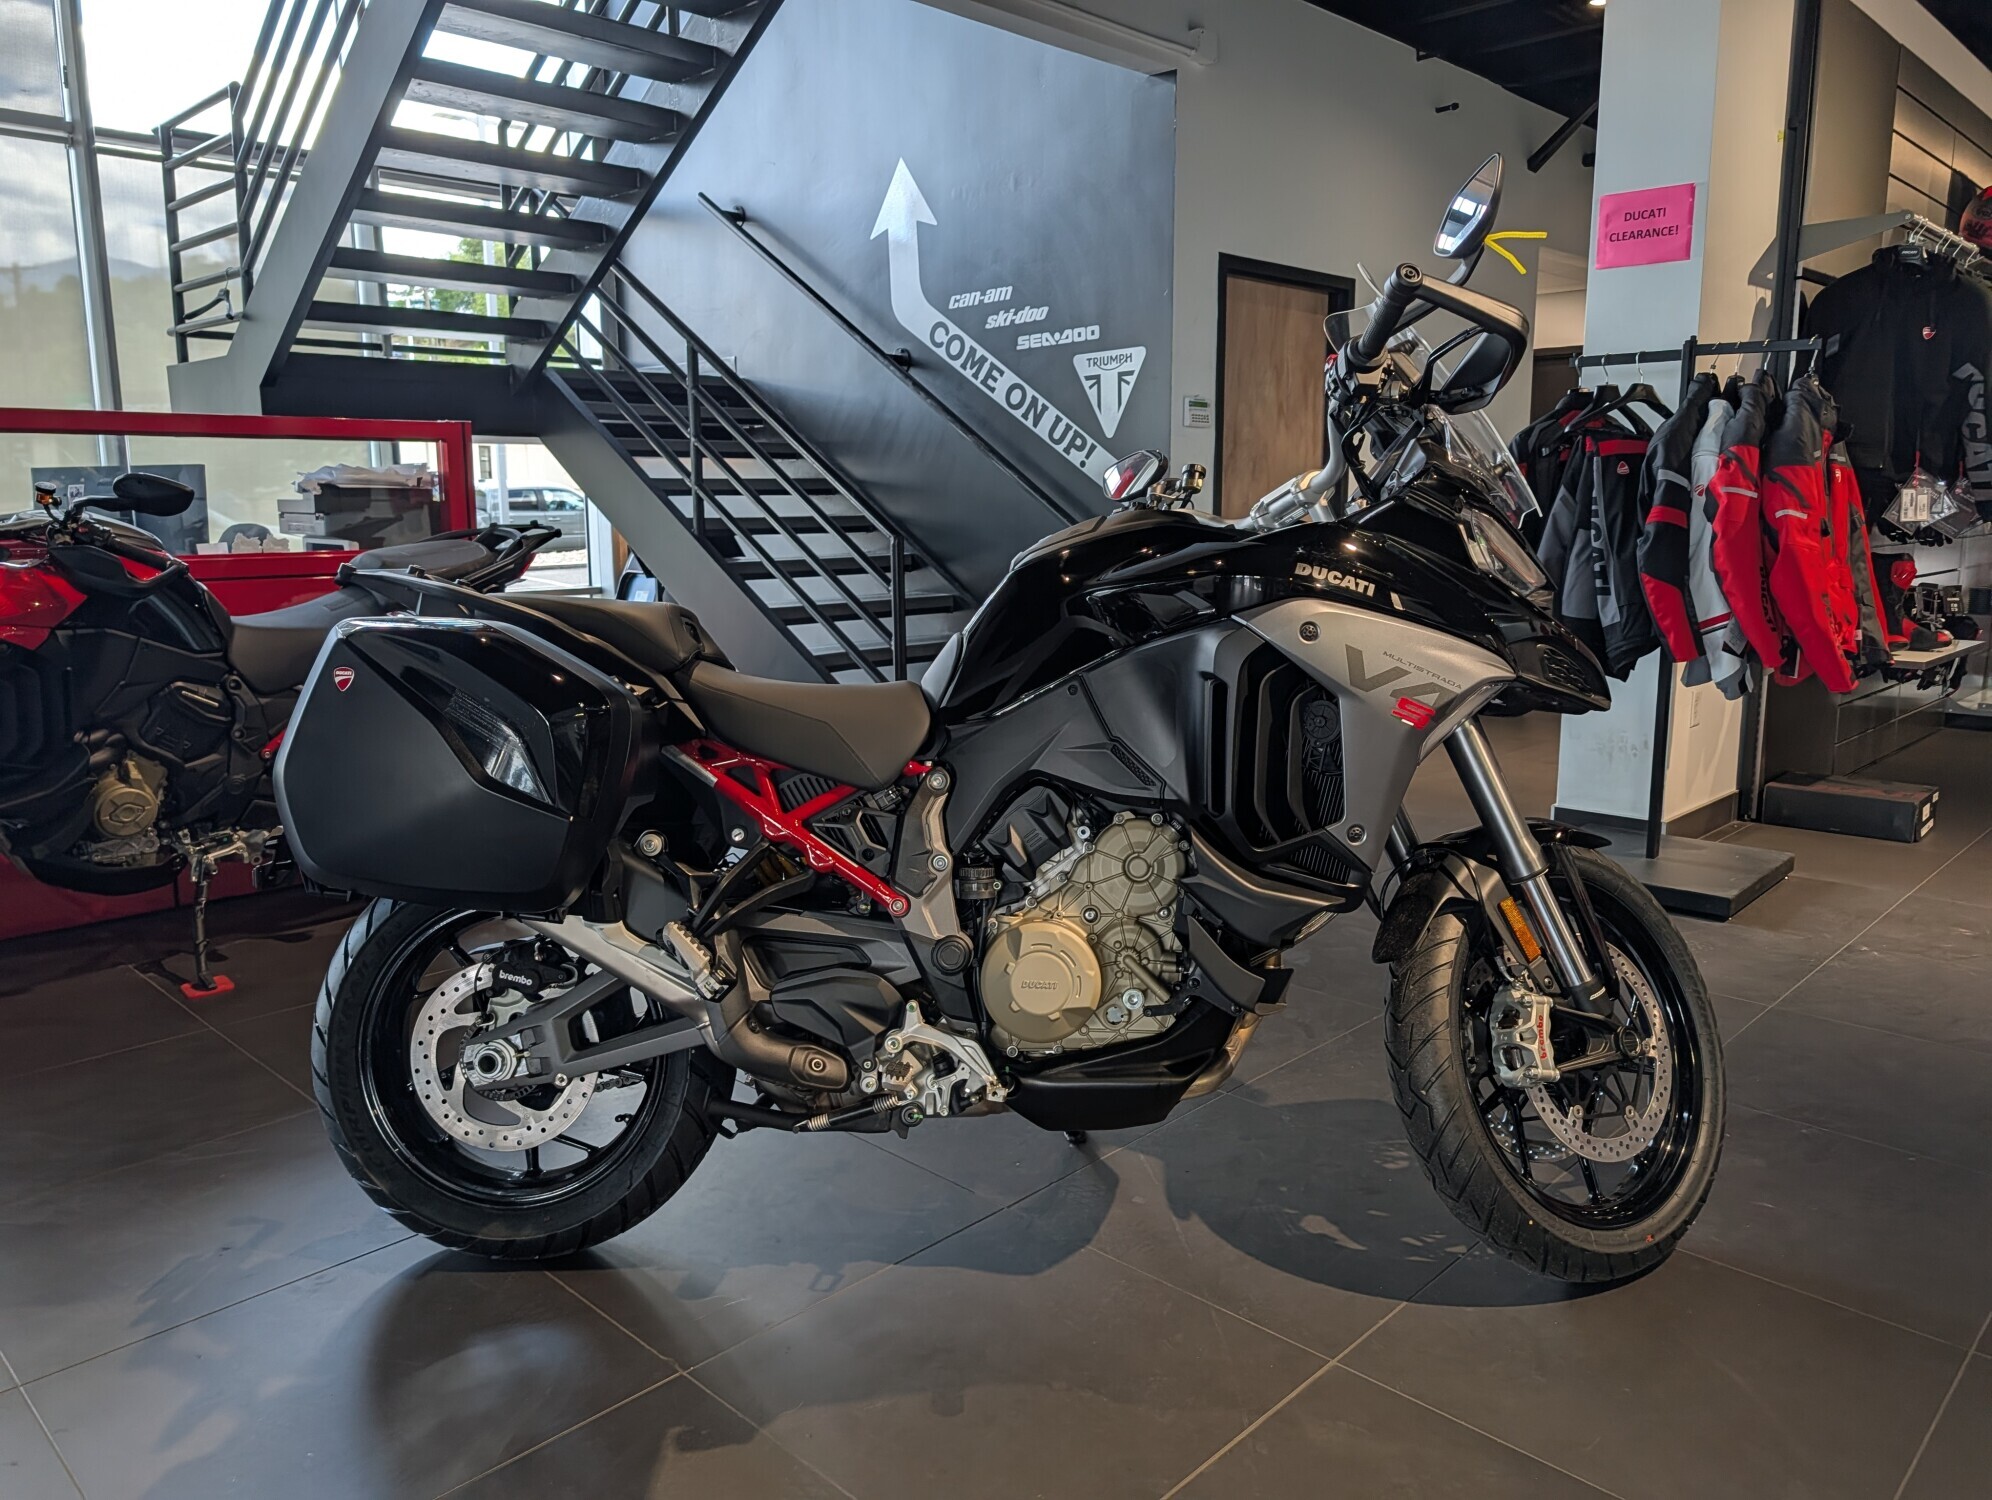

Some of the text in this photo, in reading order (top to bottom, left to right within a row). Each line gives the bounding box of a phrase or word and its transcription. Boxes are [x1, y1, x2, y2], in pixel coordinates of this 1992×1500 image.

[1624, 207, 1667, 222] DUCATI
[1609, 224, 1679, 243] CLEARANCE!
[948, 285, 1013, 309] can-am
[985, 305, 1049, 329] ski-doo
[1086, 352, 1133, 369] TRIUMPH
[929, 320, 1098, 470] COME ON UP!
[1294, 562, 1376, 597] DUCATI
[1382, 650, 1462, 690] MULTISTRADA
[499, 969, 533, 986] brembo
[1021, 979, 1059, 990] DUCATI
[1537, 1014, 1548, 1060] brembo
